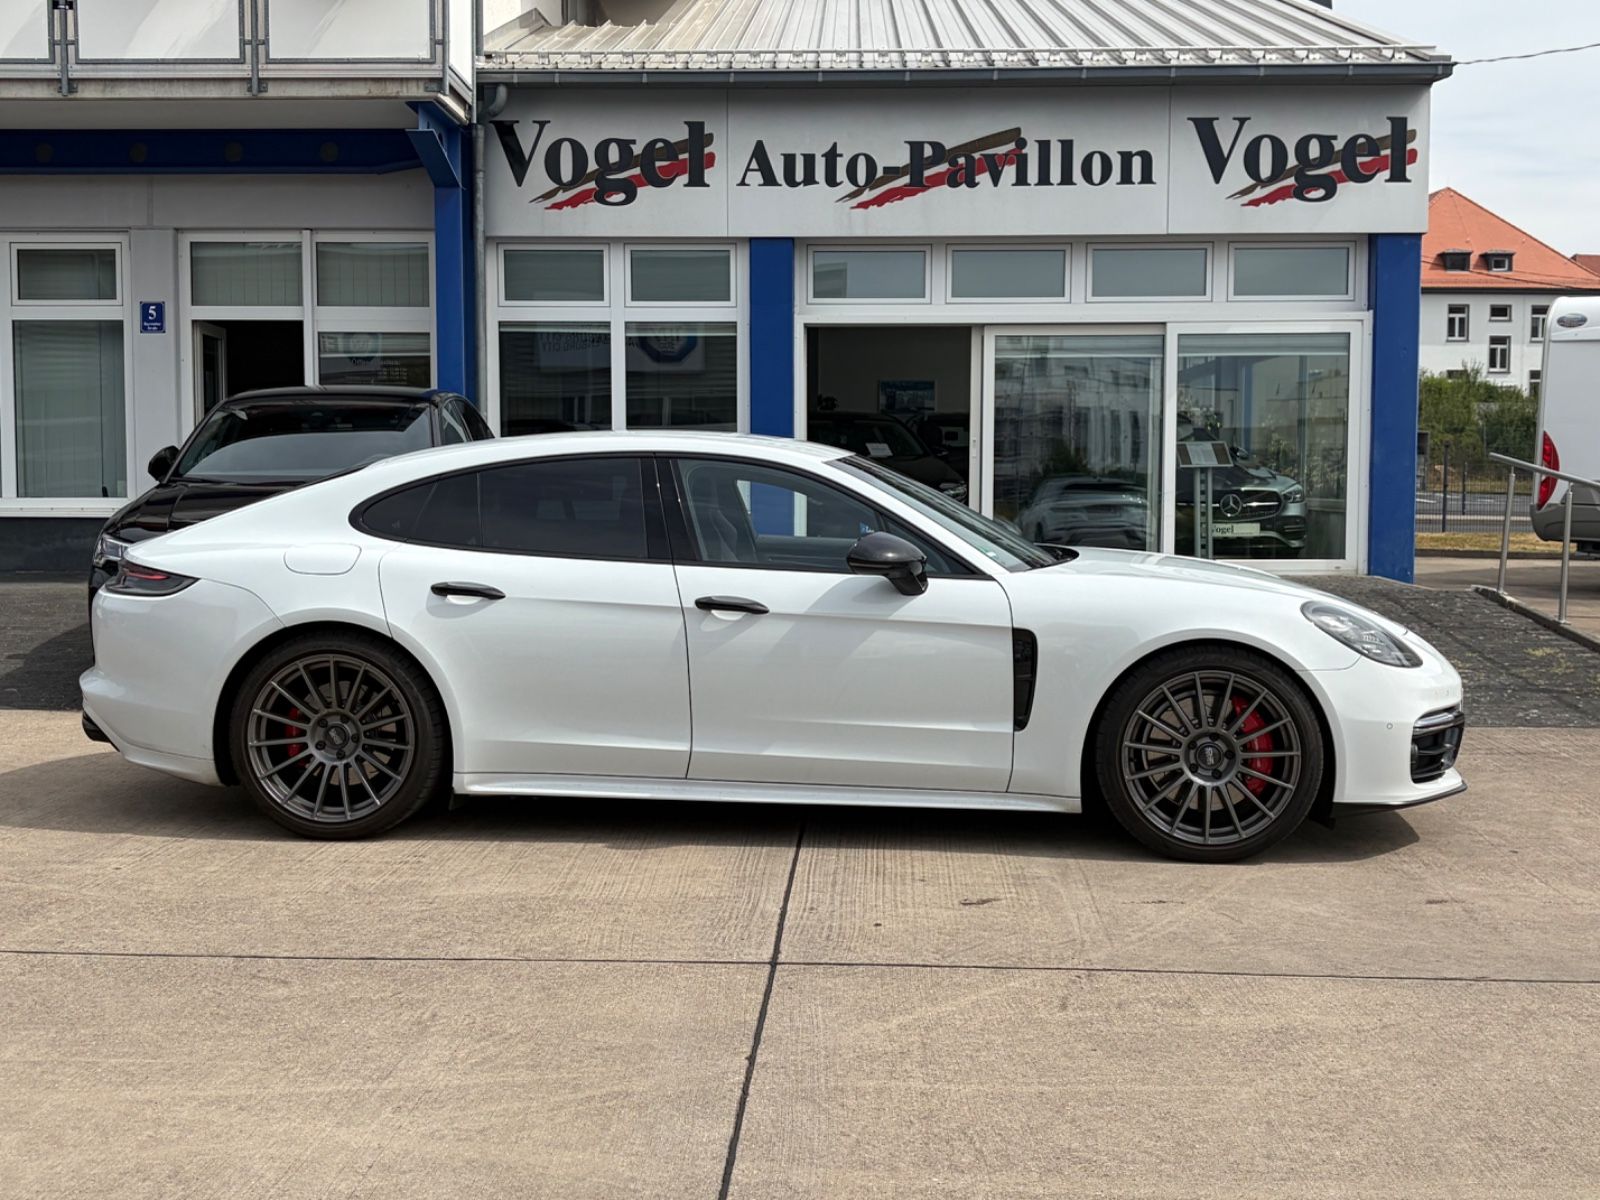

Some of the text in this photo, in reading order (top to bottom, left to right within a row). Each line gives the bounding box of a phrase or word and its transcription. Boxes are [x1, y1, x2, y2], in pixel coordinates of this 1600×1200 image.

[489, 117, 1412, 206] Vogel Auto-Pavillon Vogel
[148, 305, 157, 320] 5
